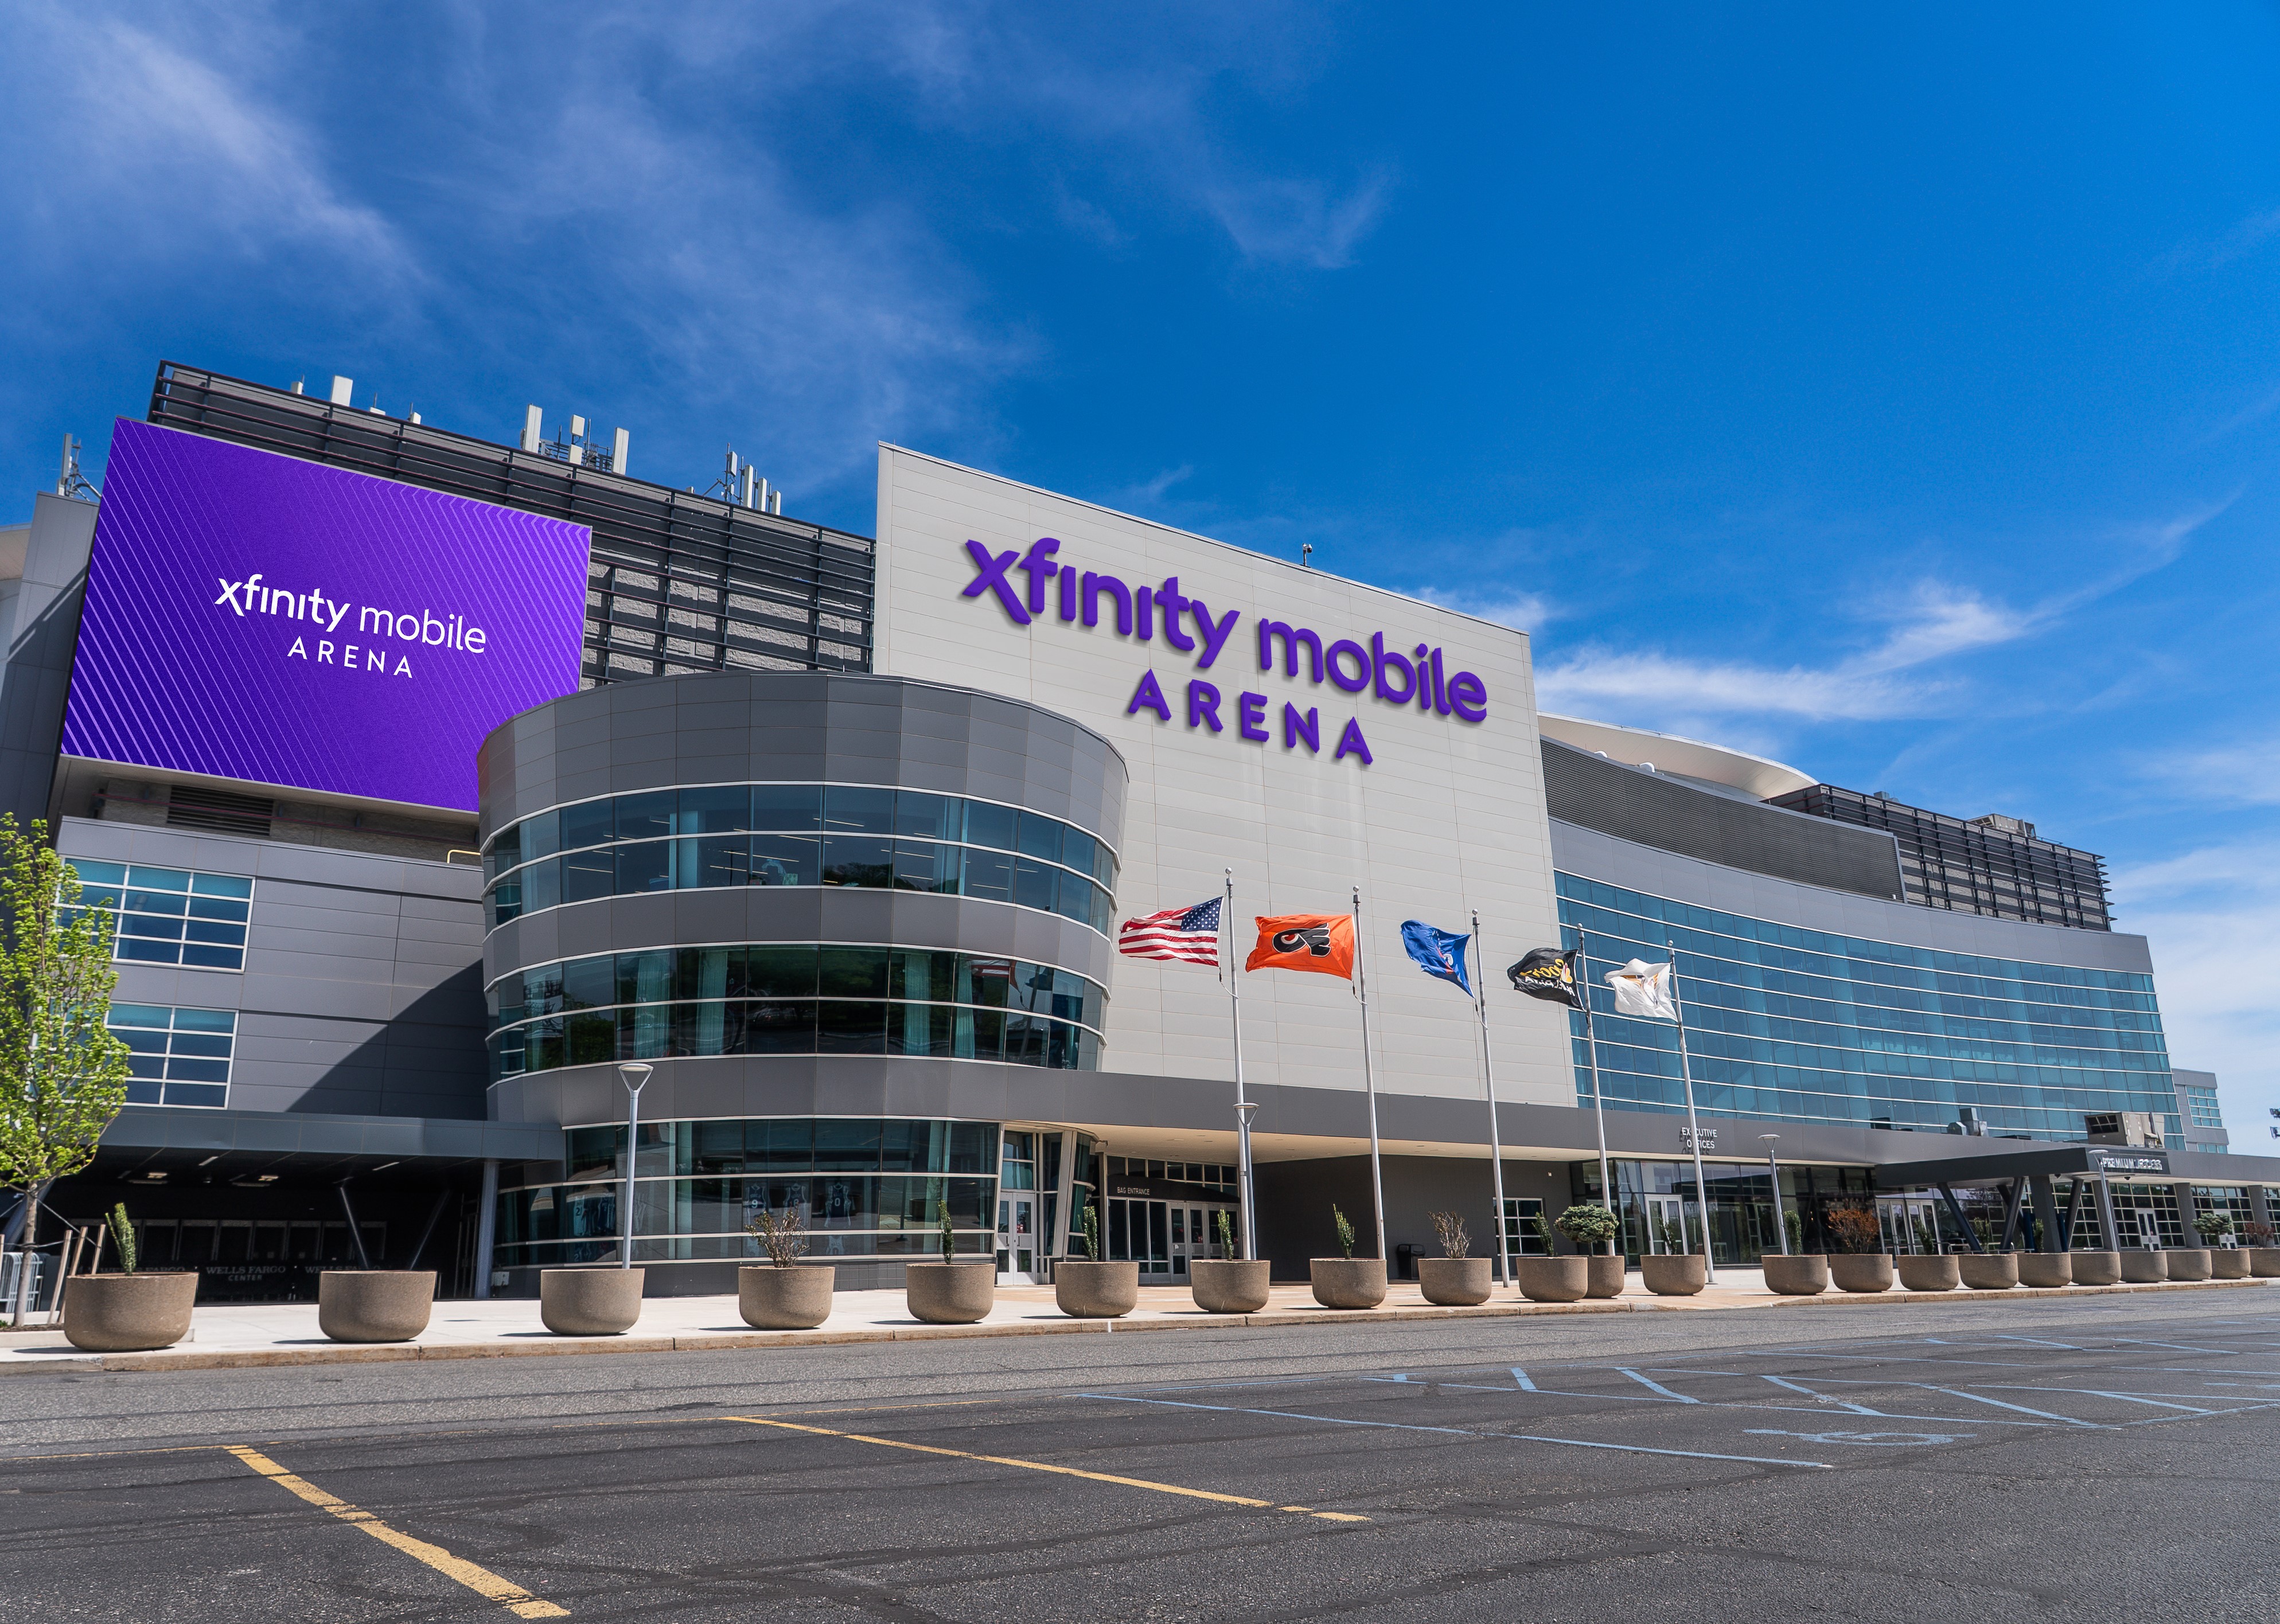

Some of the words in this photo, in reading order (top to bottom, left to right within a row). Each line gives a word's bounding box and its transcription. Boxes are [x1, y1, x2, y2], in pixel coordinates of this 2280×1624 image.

[214, 573, 351, 633] xfinity
[359, 606, 486, 654] mobile
[961, 537, 1241, 669] xfinity
[1259, 618, 1487, 723] mobile
[287, 635, 412, 678] ARENA
[1128, 669, 1374, 766] ARENA
[1682, 1127, 1717, 1138] EXCUTIVE
[1686, 1139, 1715, 1149] OFICES
[206, 1266, 245, 1275] WELLS
[248, 1266, 286, 1274] FARGO
